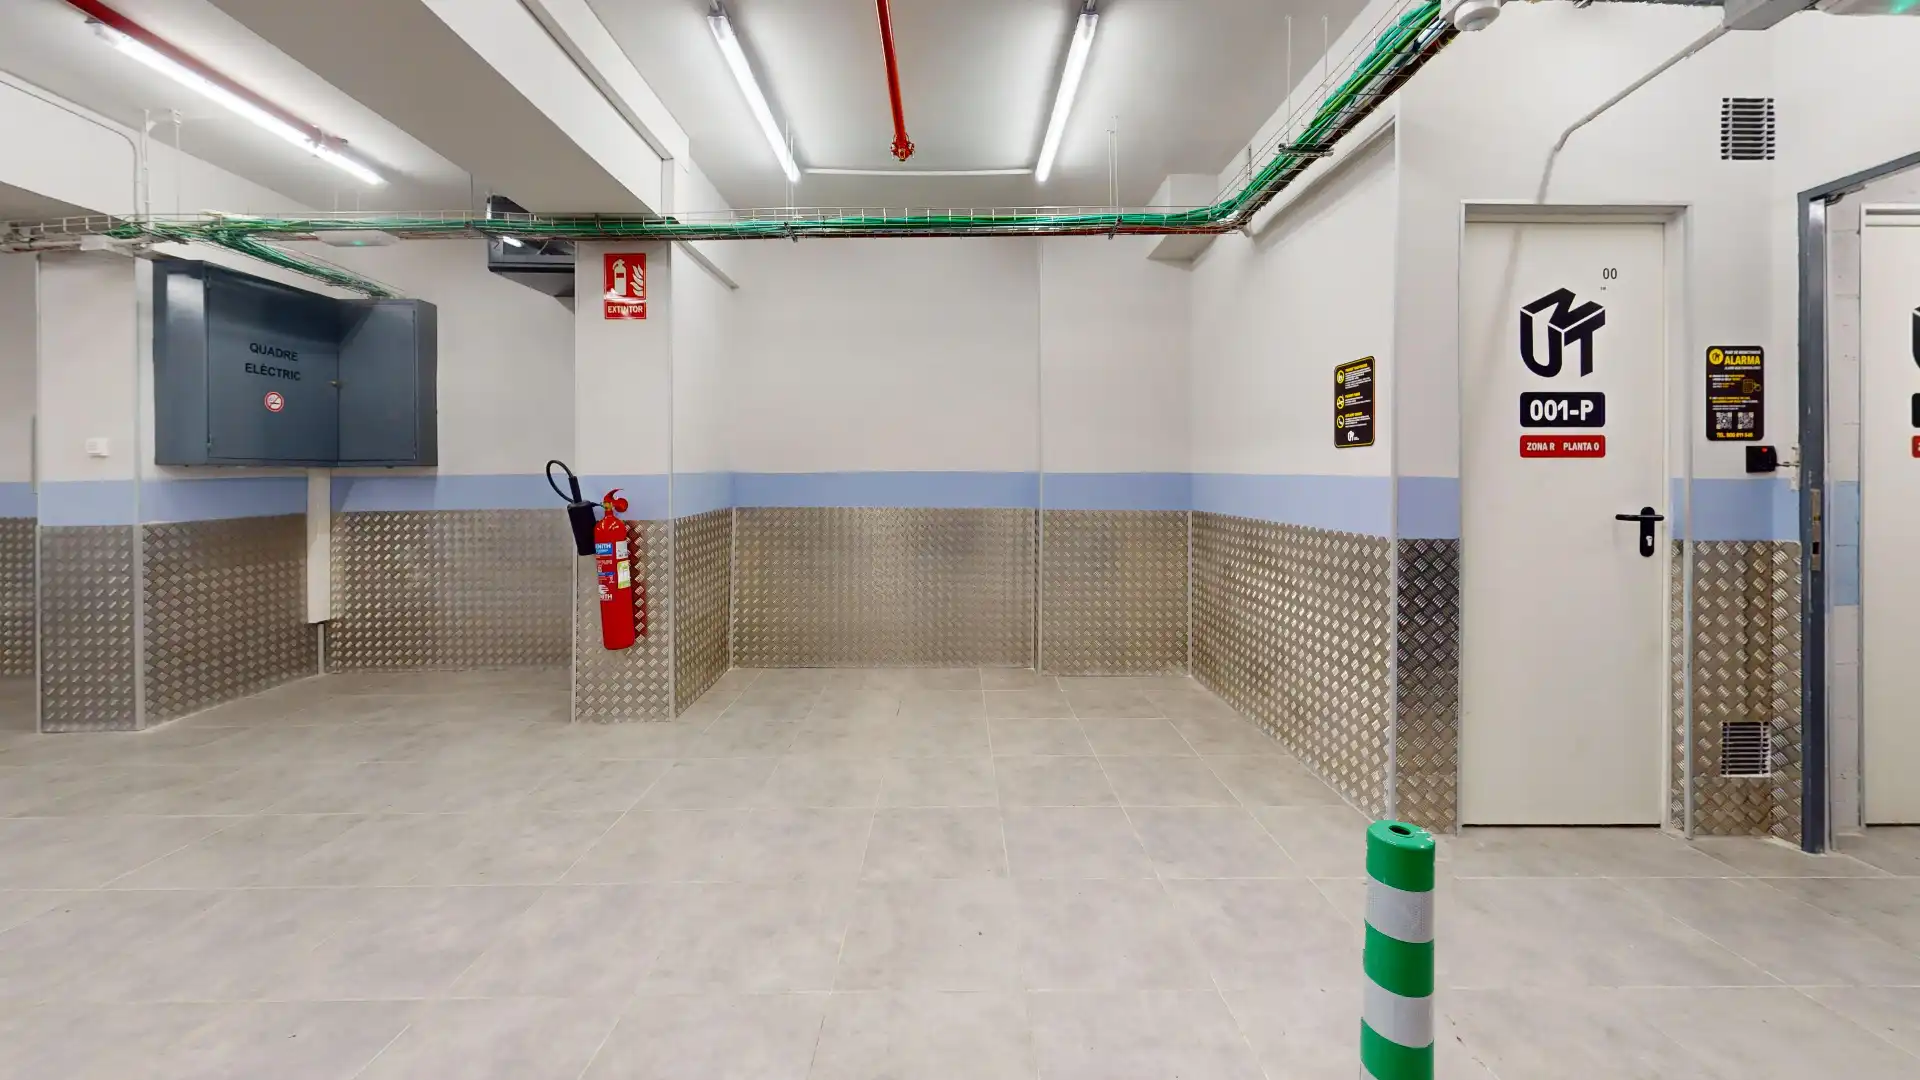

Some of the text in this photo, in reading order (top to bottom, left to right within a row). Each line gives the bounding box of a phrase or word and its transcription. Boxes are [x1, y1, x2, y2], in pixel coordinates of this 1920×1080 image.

[1603, 268, 1617, 279] 00
[607, 305, 643, 313] EXTINTOR
[250, 343, 298, 361] QUADRE
[1724, 356, 1760, 365] ALARMA
[1530, 400, 1594, 421] 001-P
[1526, 442, 1555, 451] ZONA R
[1563, 442, 1592, 451] PLANTA
